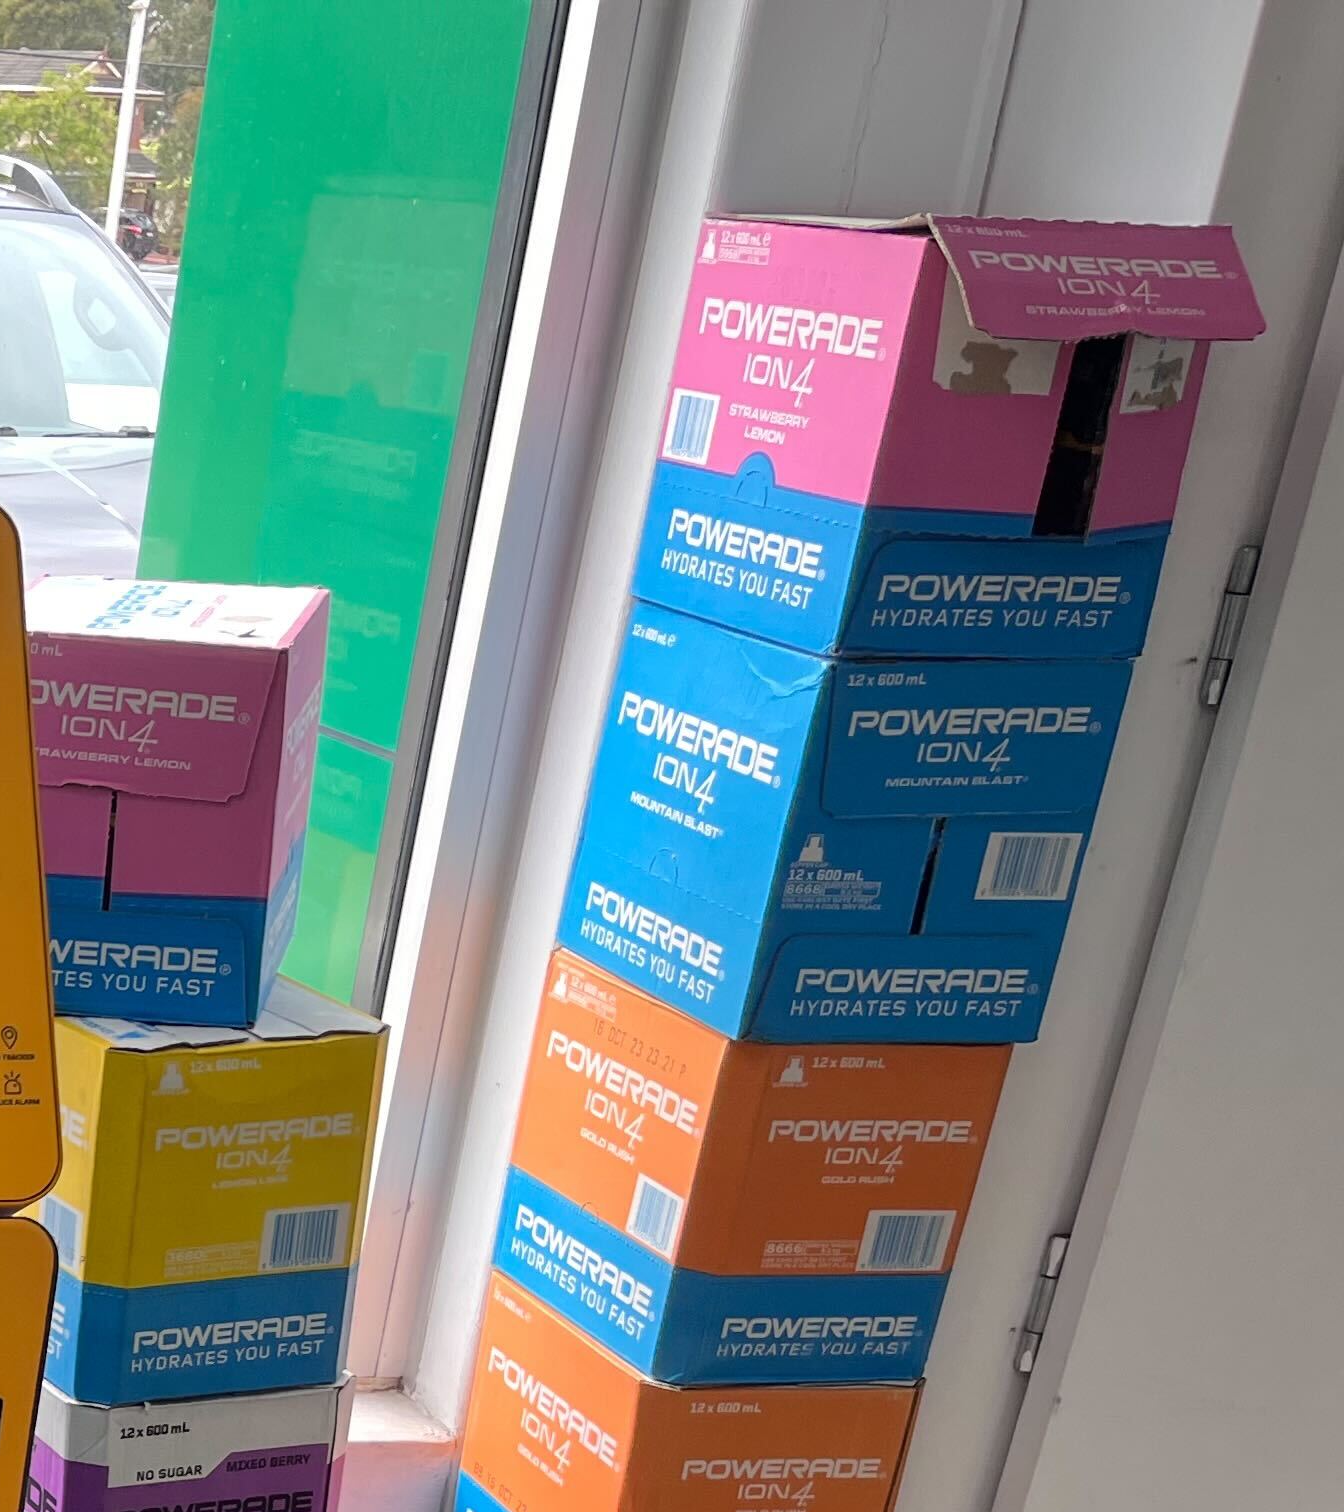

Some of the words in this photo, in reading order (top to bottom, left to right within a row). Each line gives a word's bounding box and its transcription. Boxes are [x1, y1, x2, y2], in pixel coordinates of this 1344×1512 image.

[968, 249, 1222, 280] POWERADE
[698, 297, 883, 359] POWERADE
[728, 401, 809, 431] STRAWBERRY
[744, 427, 786, 446] LEMON
[667, 509, 823, 579] POWERADE
[878, 574, 1123, 604] POWERADE
[871, 608, 994, 628] HYDRATES
[1002, 608, 1047, 628] YOU
[1055, 608, 1113, 628] FAST
[847, 706, 1091, 737] POWERADE
[618, 691, 778, 785] POWERADE
[916, 738, 1011, 771] ION4
[885, 776, 969, 788] MOUNTAIN
[972, 775, 1023, 786] BLAST
[547, 1029, 699, 1135] POWERADE
[768, 1119, 974, 1143] POWERADE
[133, 1312, 328, 1354] POWERADE
[720, 1317, 918, 1339] POWERADE
[136, 1470, 155, 1482] NO
[158, 1464, 203, 1479] SUGAR
[226, 1457, 267, 1473] MIXED
[270, 1453, 311, 1469] BERRY
[681, 1458, 881, 1481] POWERADE
